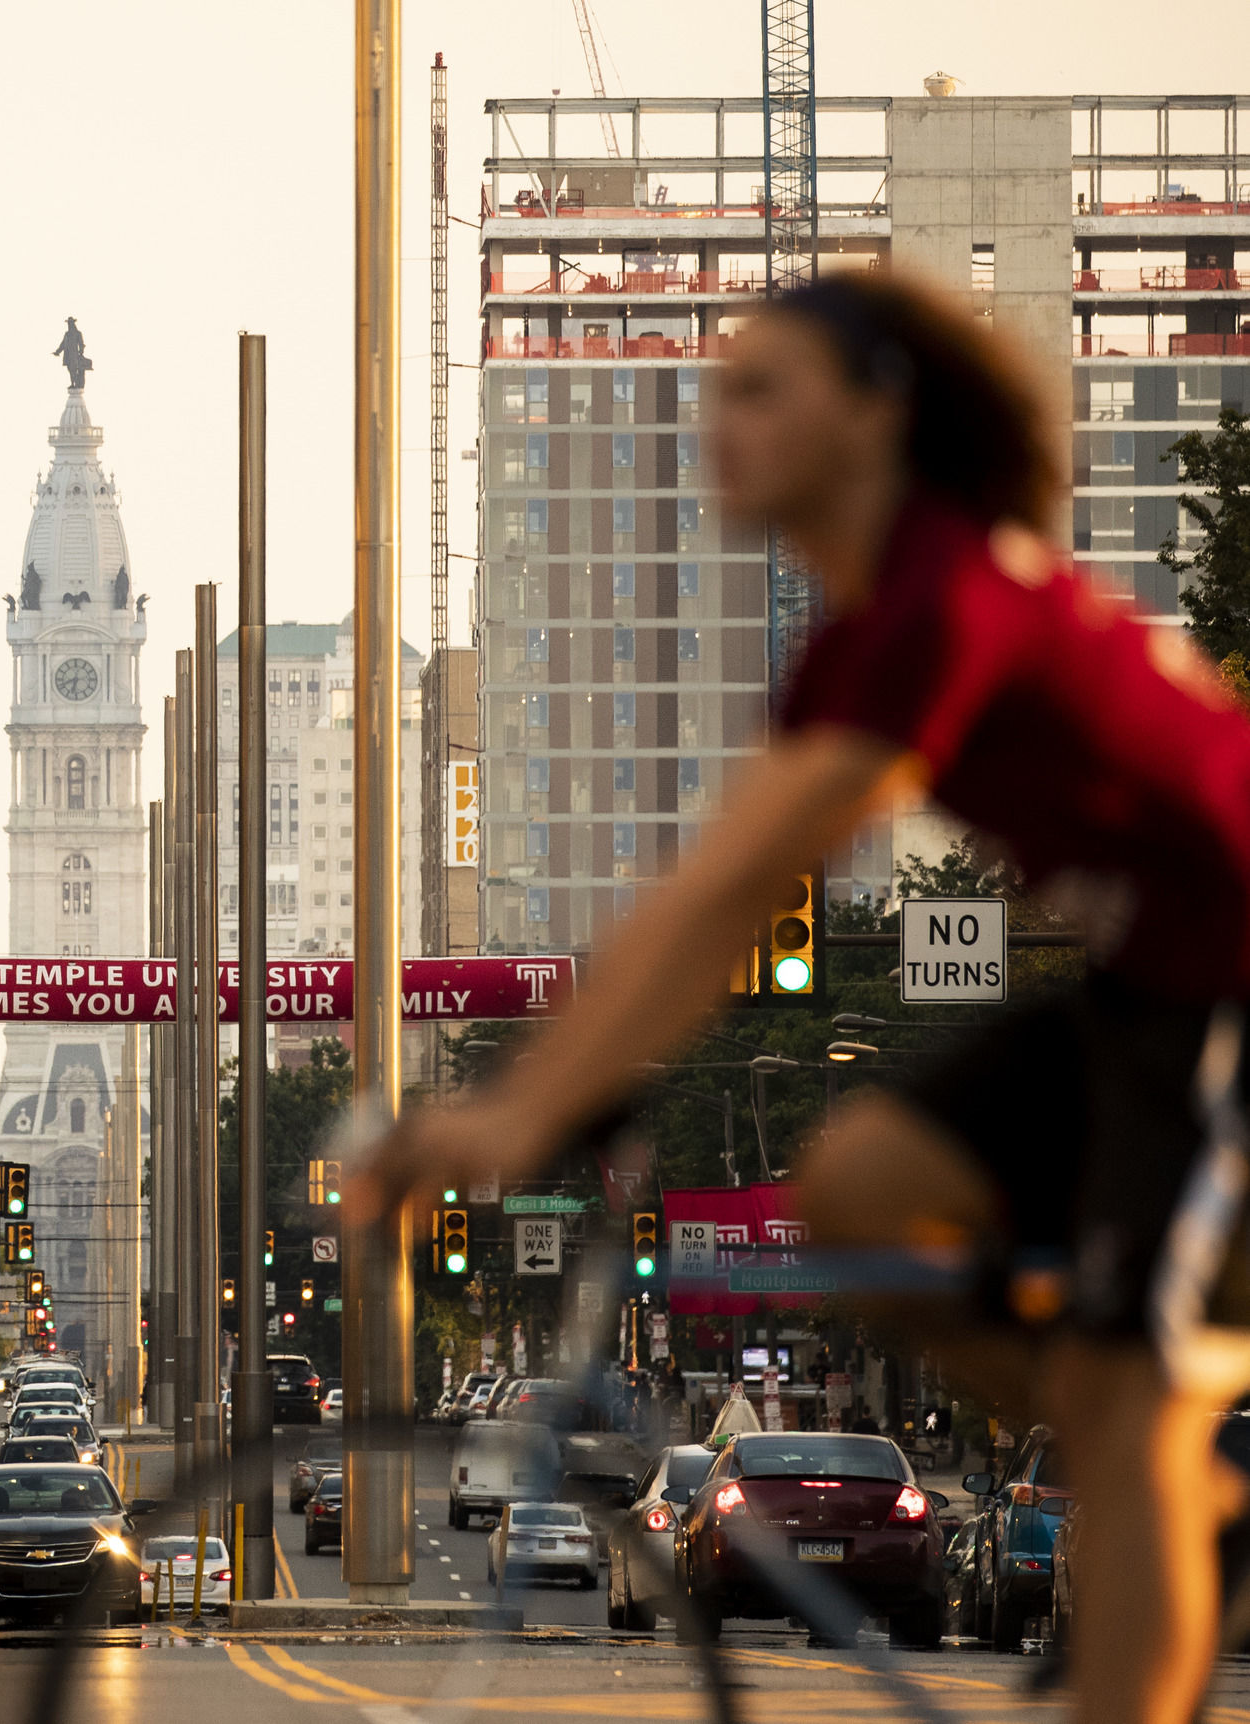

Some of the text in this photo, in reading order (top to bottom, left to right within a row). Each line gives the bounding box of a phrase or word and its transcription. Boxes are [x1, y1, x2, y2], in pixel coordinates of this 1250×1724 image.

[929, 914, 979, 946] NO
[907, 961, 1000, 987] TURNS
[66, 993, 135, 1015] YOU
[266, 994, 334, 1016] OUR
[401, 990, 471, 1014] MILY
[525, 1225, 552, 1238] ONE
[681, 1226, 705, 1239] NO
[524, 1240, 554, 1251] WAY
[680, 1240, 707, 1250] TURN
[685, 1251, 701, 1261] ON
[681, 1262, 703, 1273] RED
[741, 1273, 839, 1291] Montgomery
